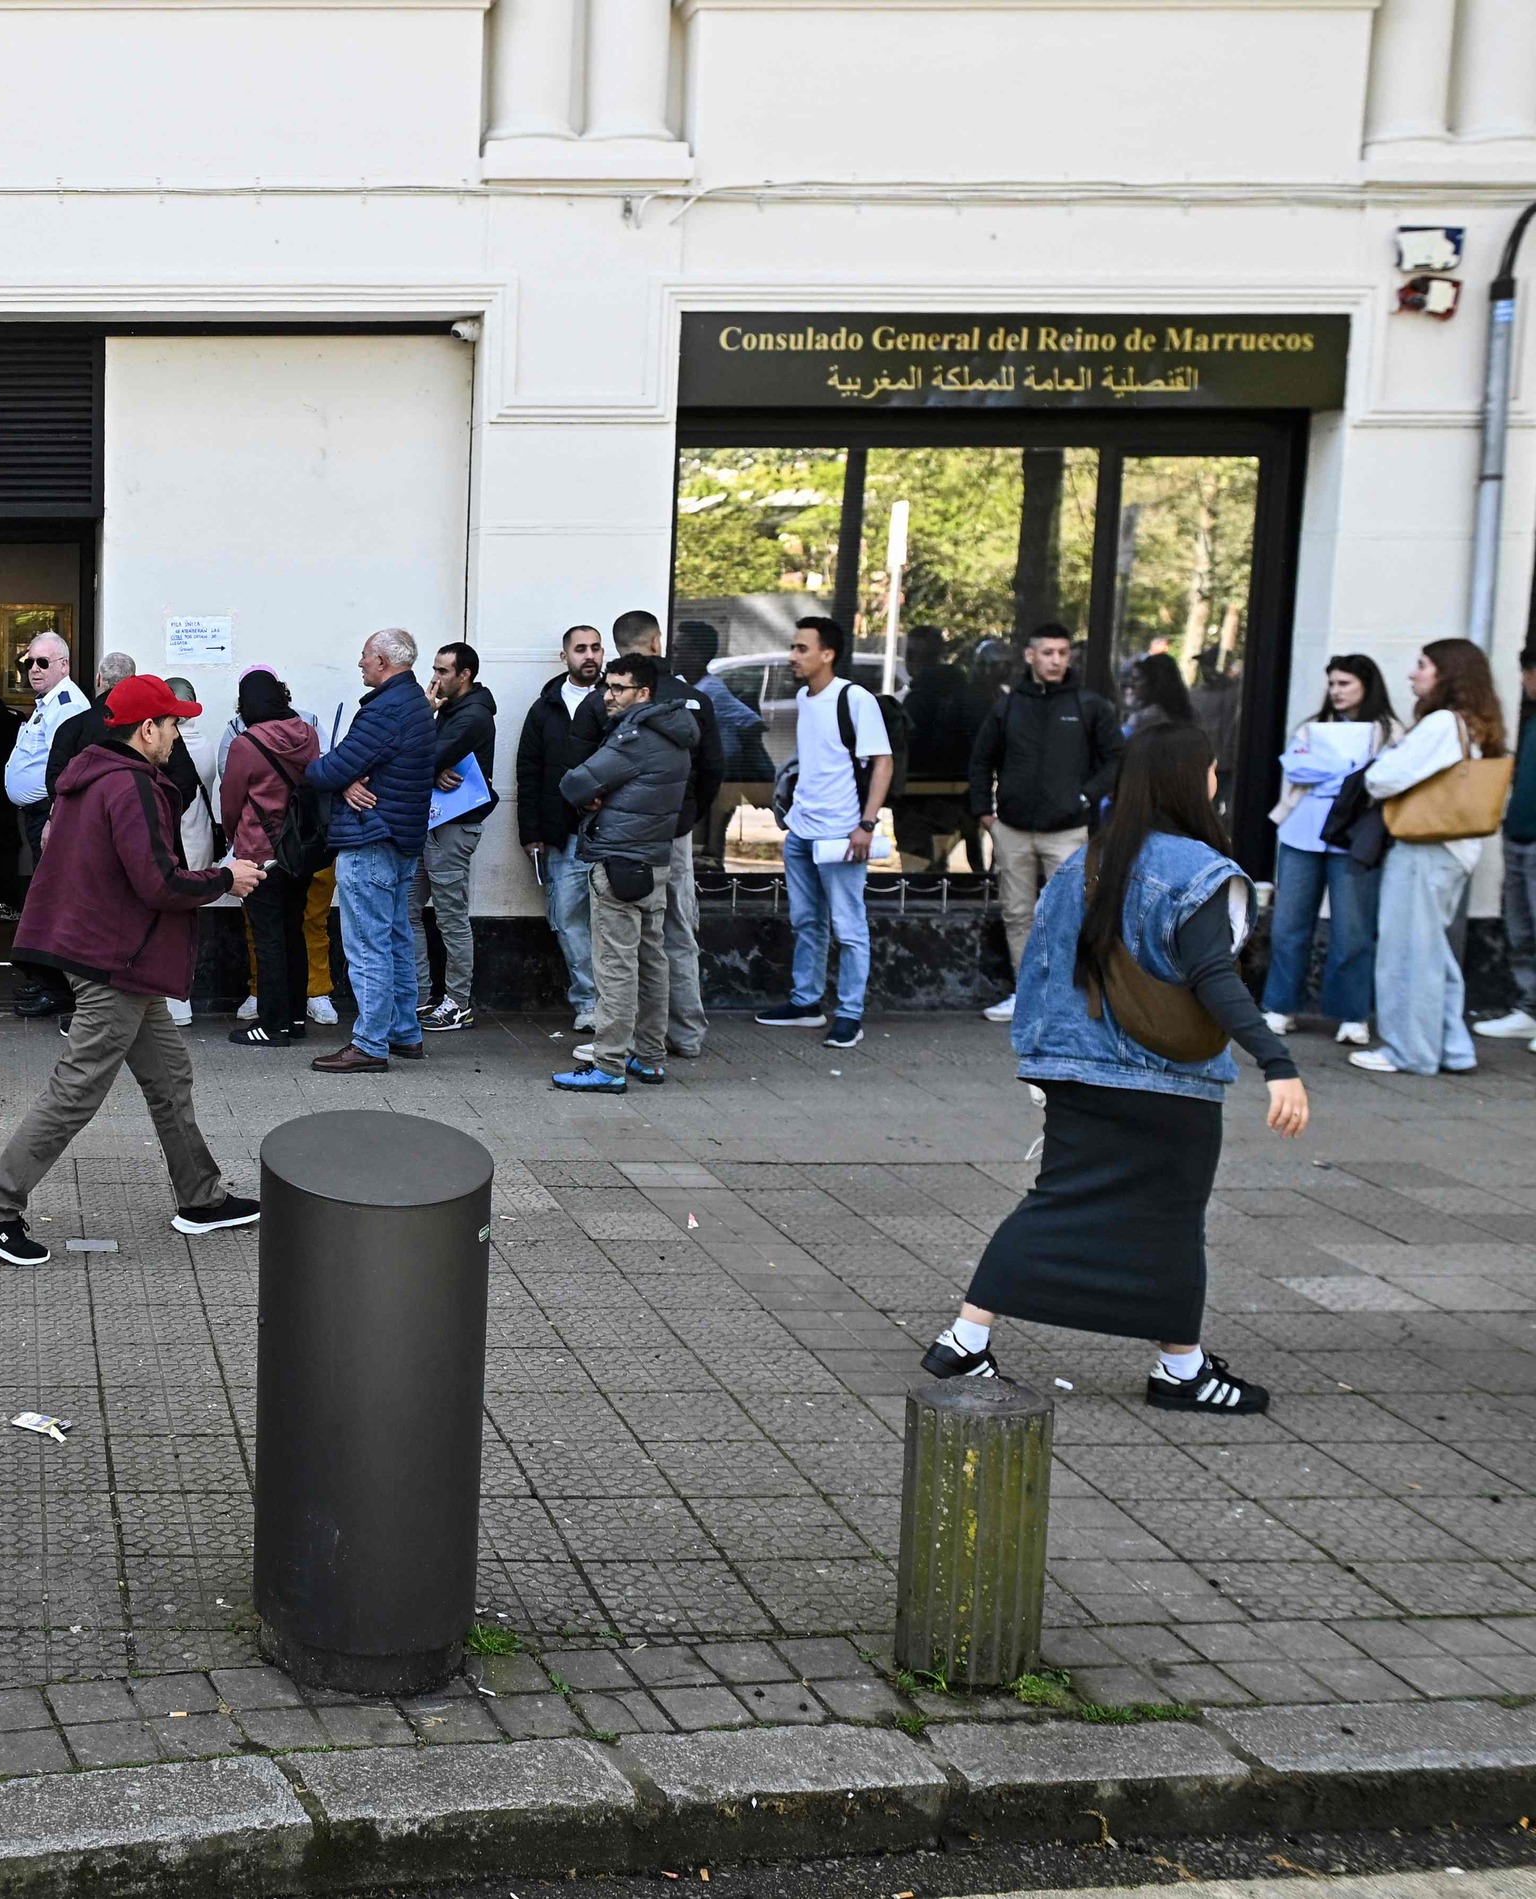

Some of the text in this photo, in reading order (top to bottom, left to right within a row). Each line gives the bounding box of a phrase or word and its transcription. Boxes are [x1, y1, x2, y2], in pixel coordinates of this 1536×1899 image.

[719, 325, 1314, 353] Consulado General del Reino de Marruecos
[827, 364, 1199, 400] القنصلية العامة للمملكة المغربية
